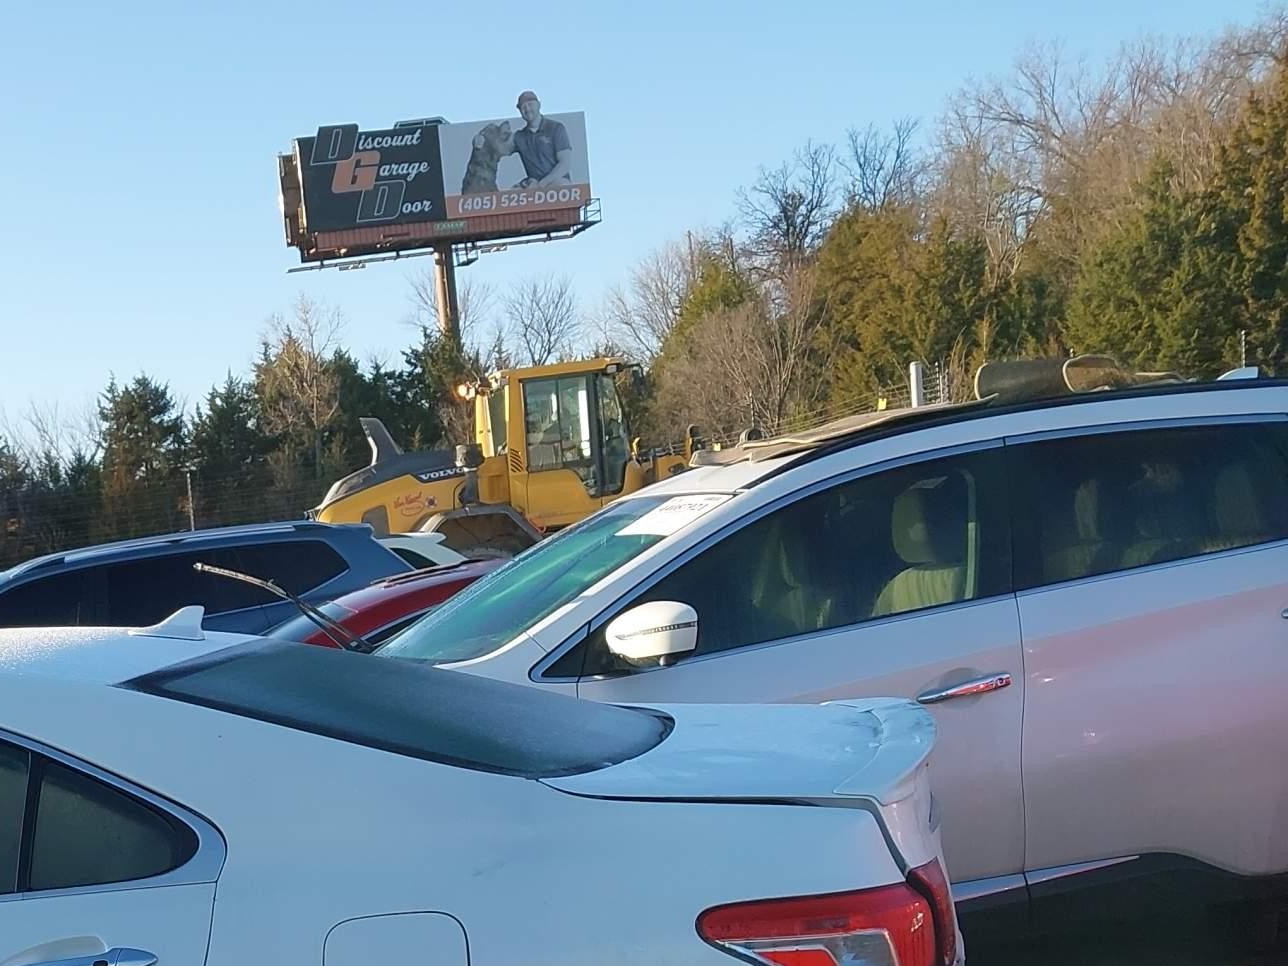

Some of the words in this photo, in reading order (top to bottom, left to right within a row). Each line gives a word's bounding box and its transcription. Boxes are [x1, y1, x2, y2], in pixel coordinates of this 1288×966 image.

[310, 123, 421, 166] Discount
[332, 150, 431, 194] Garage
[357, 179, 433, 223] Door
[458, 194, 497, 213] (405)
[501, 187, 582, 208] 525-DOOR
[419, 467, 465, 480] VOLVO
